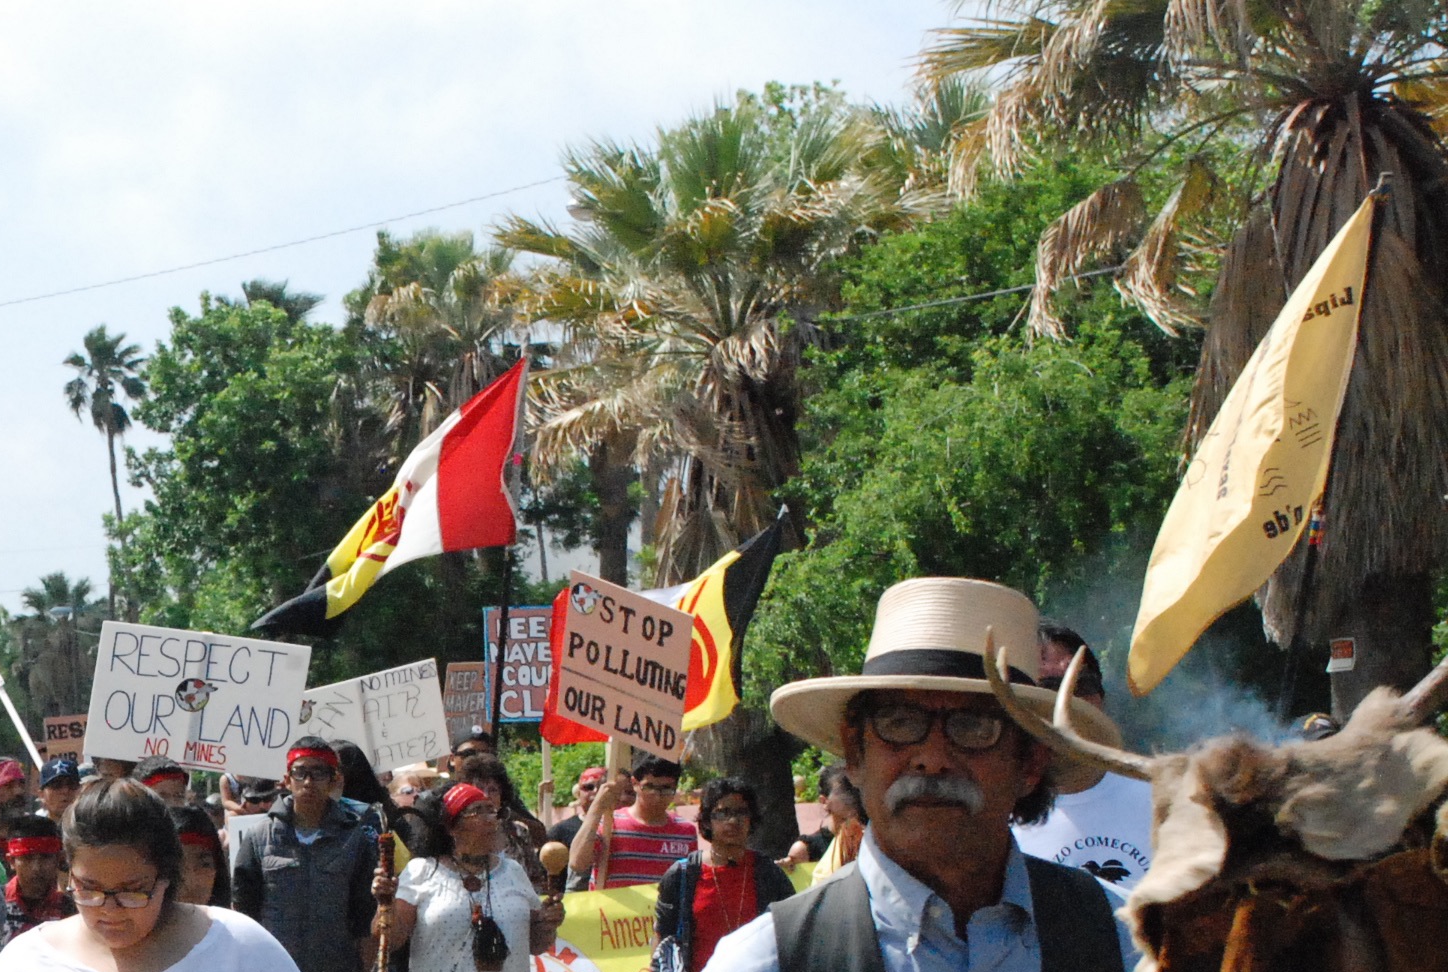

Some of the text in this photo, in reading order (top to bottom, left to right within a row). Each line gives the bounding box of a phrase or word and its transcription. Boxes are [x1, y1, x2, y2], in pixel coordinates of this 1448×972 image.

[600, 596, 673, 647] STOP
[110, 631, 288, 686] RESPECT
[503, 665, 552, 686] COU
[568, 632, 687, 700] POLLUTING
[360, 662, 437, 693] NO MINES
[105, 690, 291, 748] OUR LAND
[363, 684, 425, 722] AIR
[445, 692, 485, 712] MAVER
[500, 690, 548, 717] CL
[564, 686, 676, 750] OUR LAND
[46, 721, 87, 740] RES
[144, 737, 227, 764] NO MINES
[1074, 836, 1151, 872] COMECRU
[599, 904, 654, 951] Ameri
